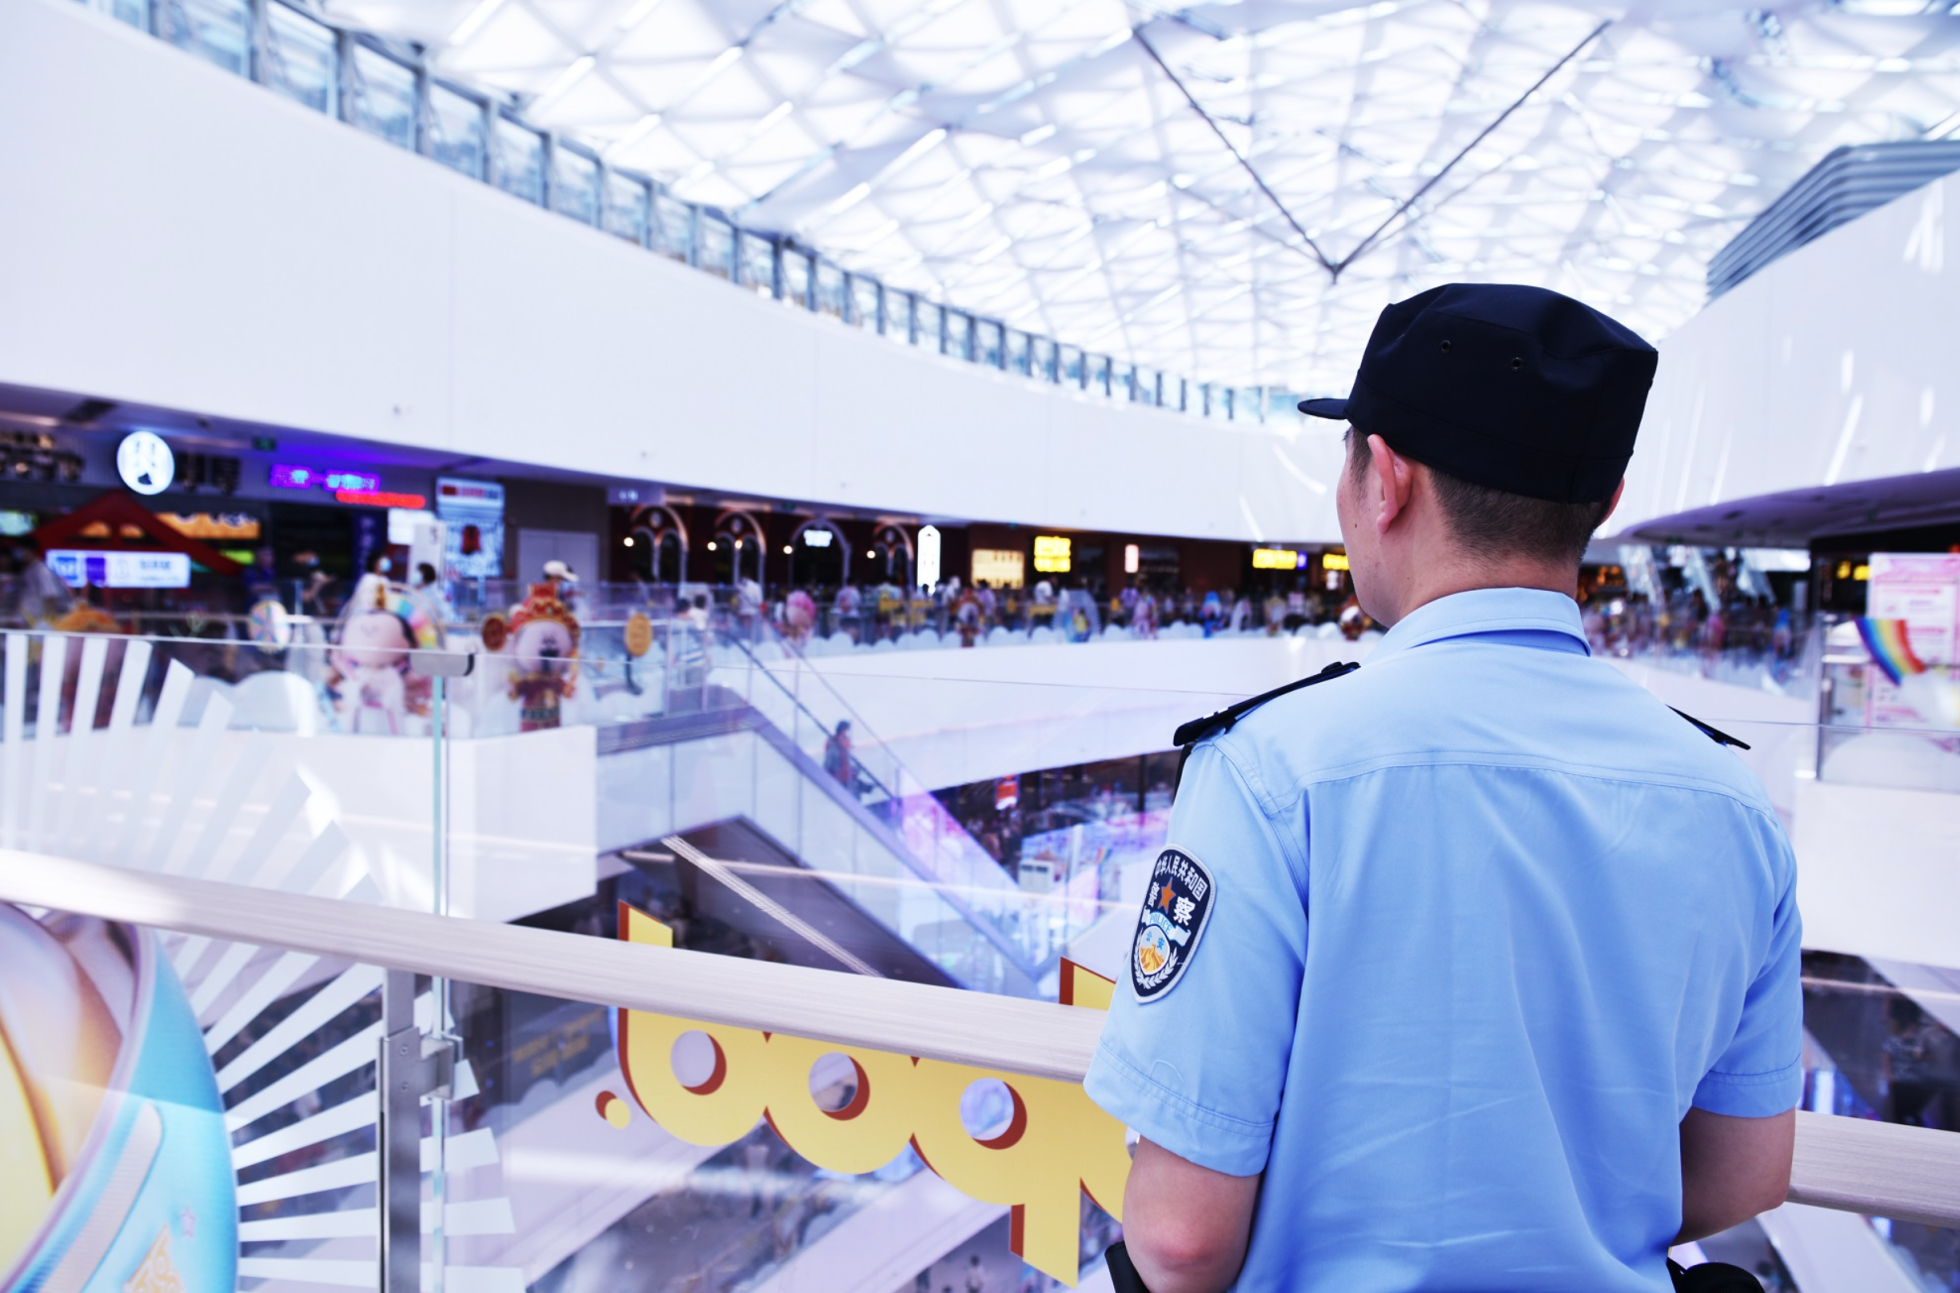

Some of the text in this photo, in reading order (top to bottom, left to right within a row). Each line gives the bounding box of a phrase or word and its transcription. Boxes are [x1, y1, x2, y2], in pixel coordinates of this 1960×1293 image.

[1155, 854, 1208, 902] 中华人民共和国
[1150, 912, 1173, 935] POLICE
